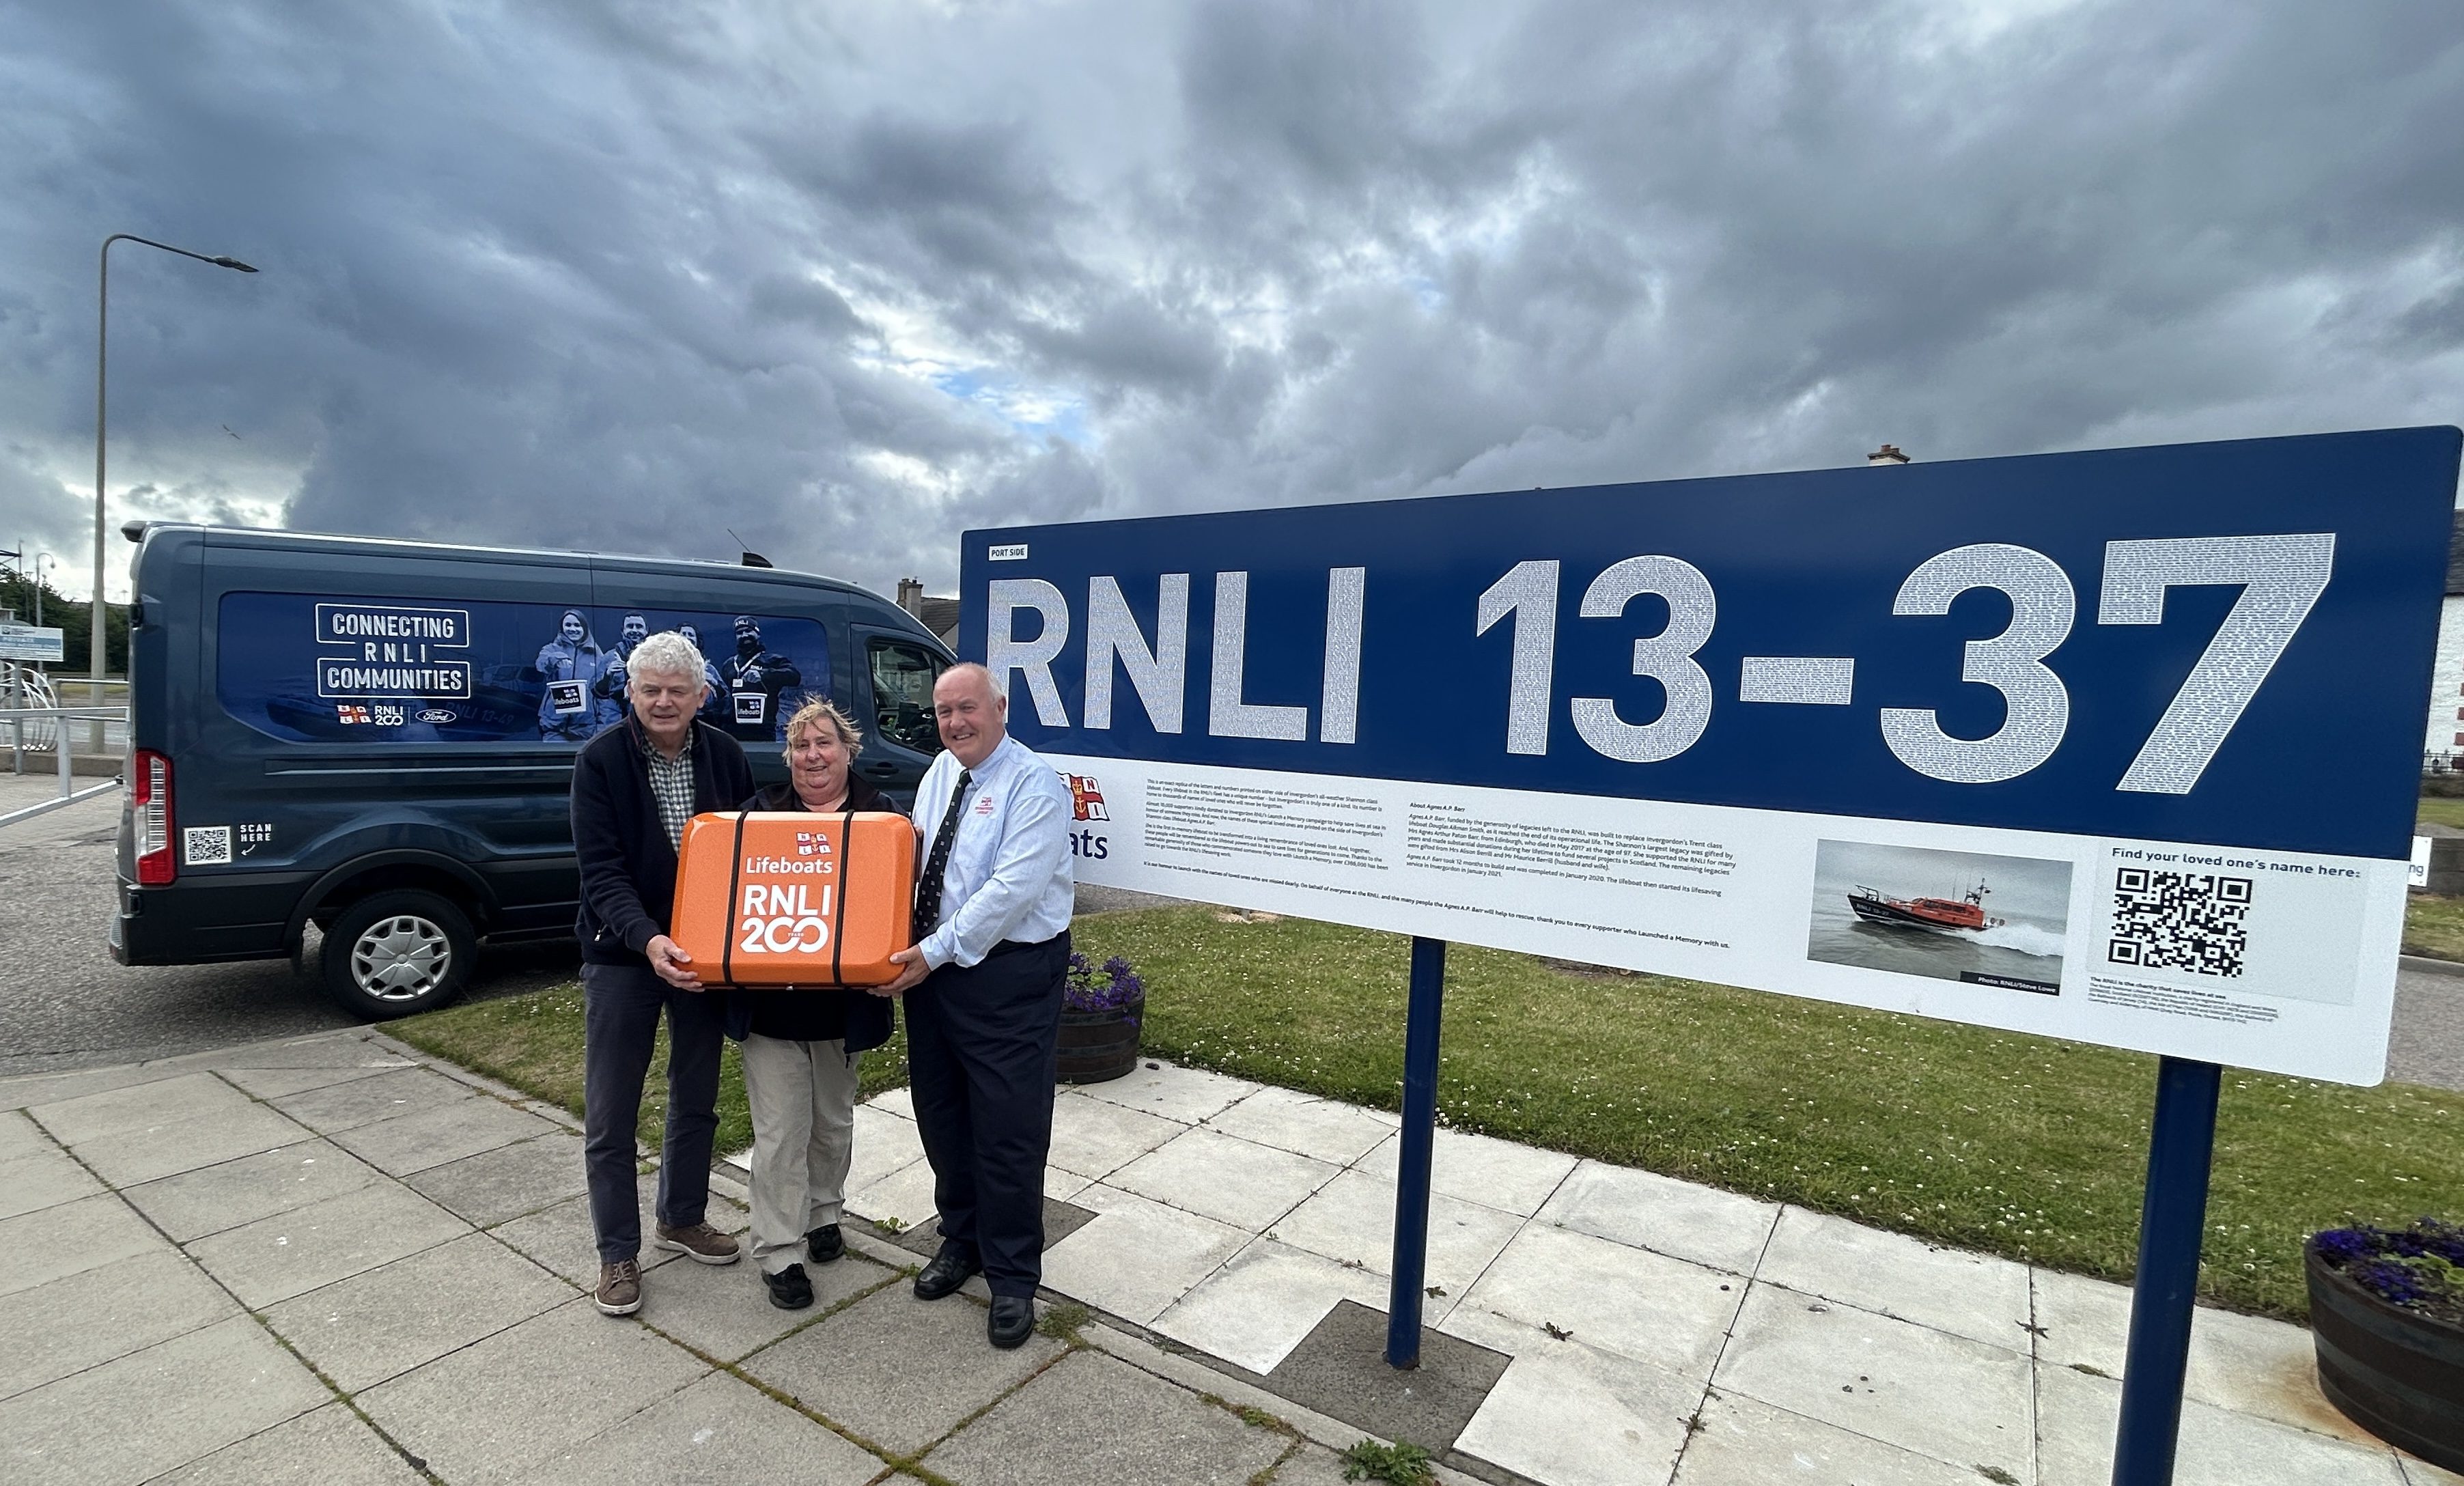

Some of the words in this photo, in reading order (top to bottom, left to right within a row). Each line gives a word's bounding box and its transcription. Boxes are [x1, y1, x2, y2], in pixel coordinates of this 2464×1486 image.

[991, 549, 1009, 557] PORT
[1009, 548, 1024, 556] SIDE
[333, 613, 454, 639] CONNECTING
[365, 642, 426, 662] RNLI
[987, 567, 1365, 744] RNLI
[1476, 532, 2336, 795] 13-37
[327, 667, 462, 690] COMMUNITIES
[375, 705, 403, 715] RNLI
[375, 715, 403, 725] 200
[423, 710, 448, 721] Ford
[240, 824, 272, 832] SCAN
[240, 833, 271, 841] HERE
[746, 856, 832, 874] Lifeboats
[2112, 847, 2142, 859] Find
[2146, 852, 2179, 863] your
[2183, 855, 2222, 866] loved
[2226, 859, 2266, 869] one's
[2270, 863, 2314, 873] name
[2319, 865, 2360, 878] here:
[743, 884, 830, 916] RNLI
[740, 916, 829, 953] 200
[1537, 915, 1553, 923] thank
[1574, 922, 1591, 930] every
[1592, 925, 1621, 933] supporter
[1638, 930, 1668, 940] Launched
[1675, 935, 1702, 946] Memory
